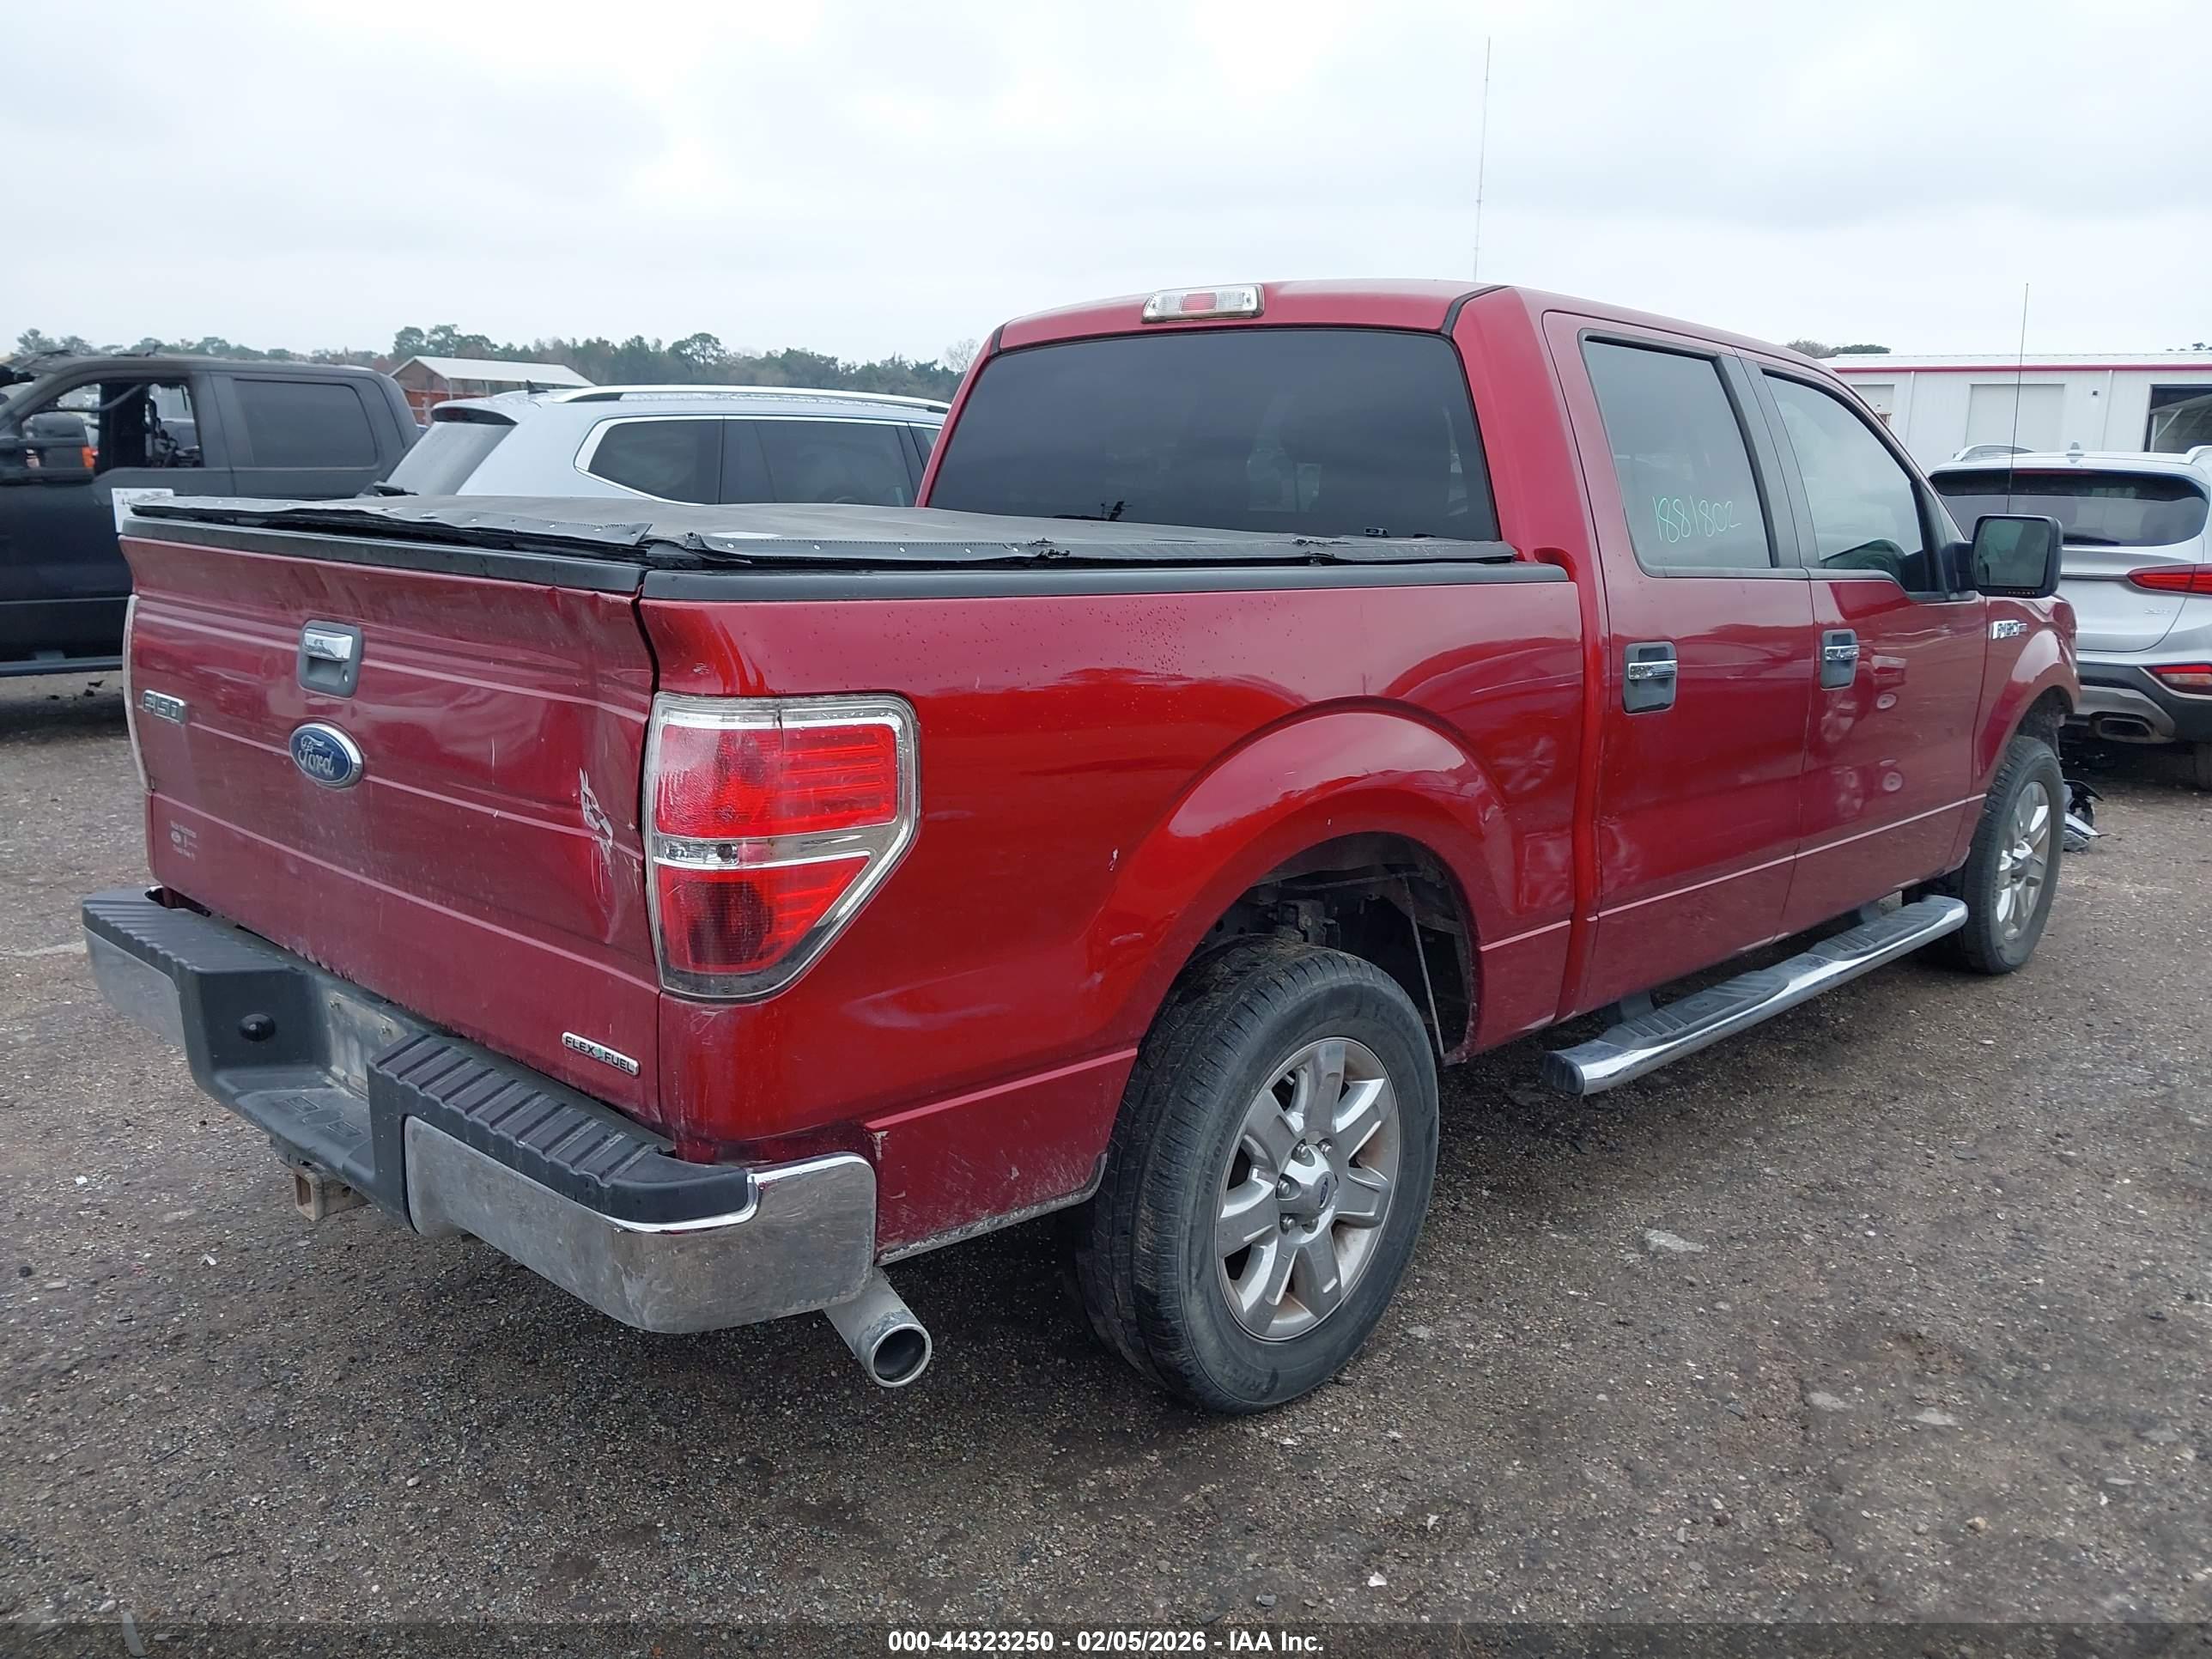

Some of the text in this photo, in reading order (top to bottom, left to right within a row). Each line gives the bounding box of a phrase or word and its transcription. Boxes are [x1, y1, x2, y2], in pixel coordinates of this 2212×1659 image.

[1651, 495, 1743, 543] 1881802
[297, 734, 335, 776] Ford
[564, 1035, 635, 1074] FLEX FUEL
